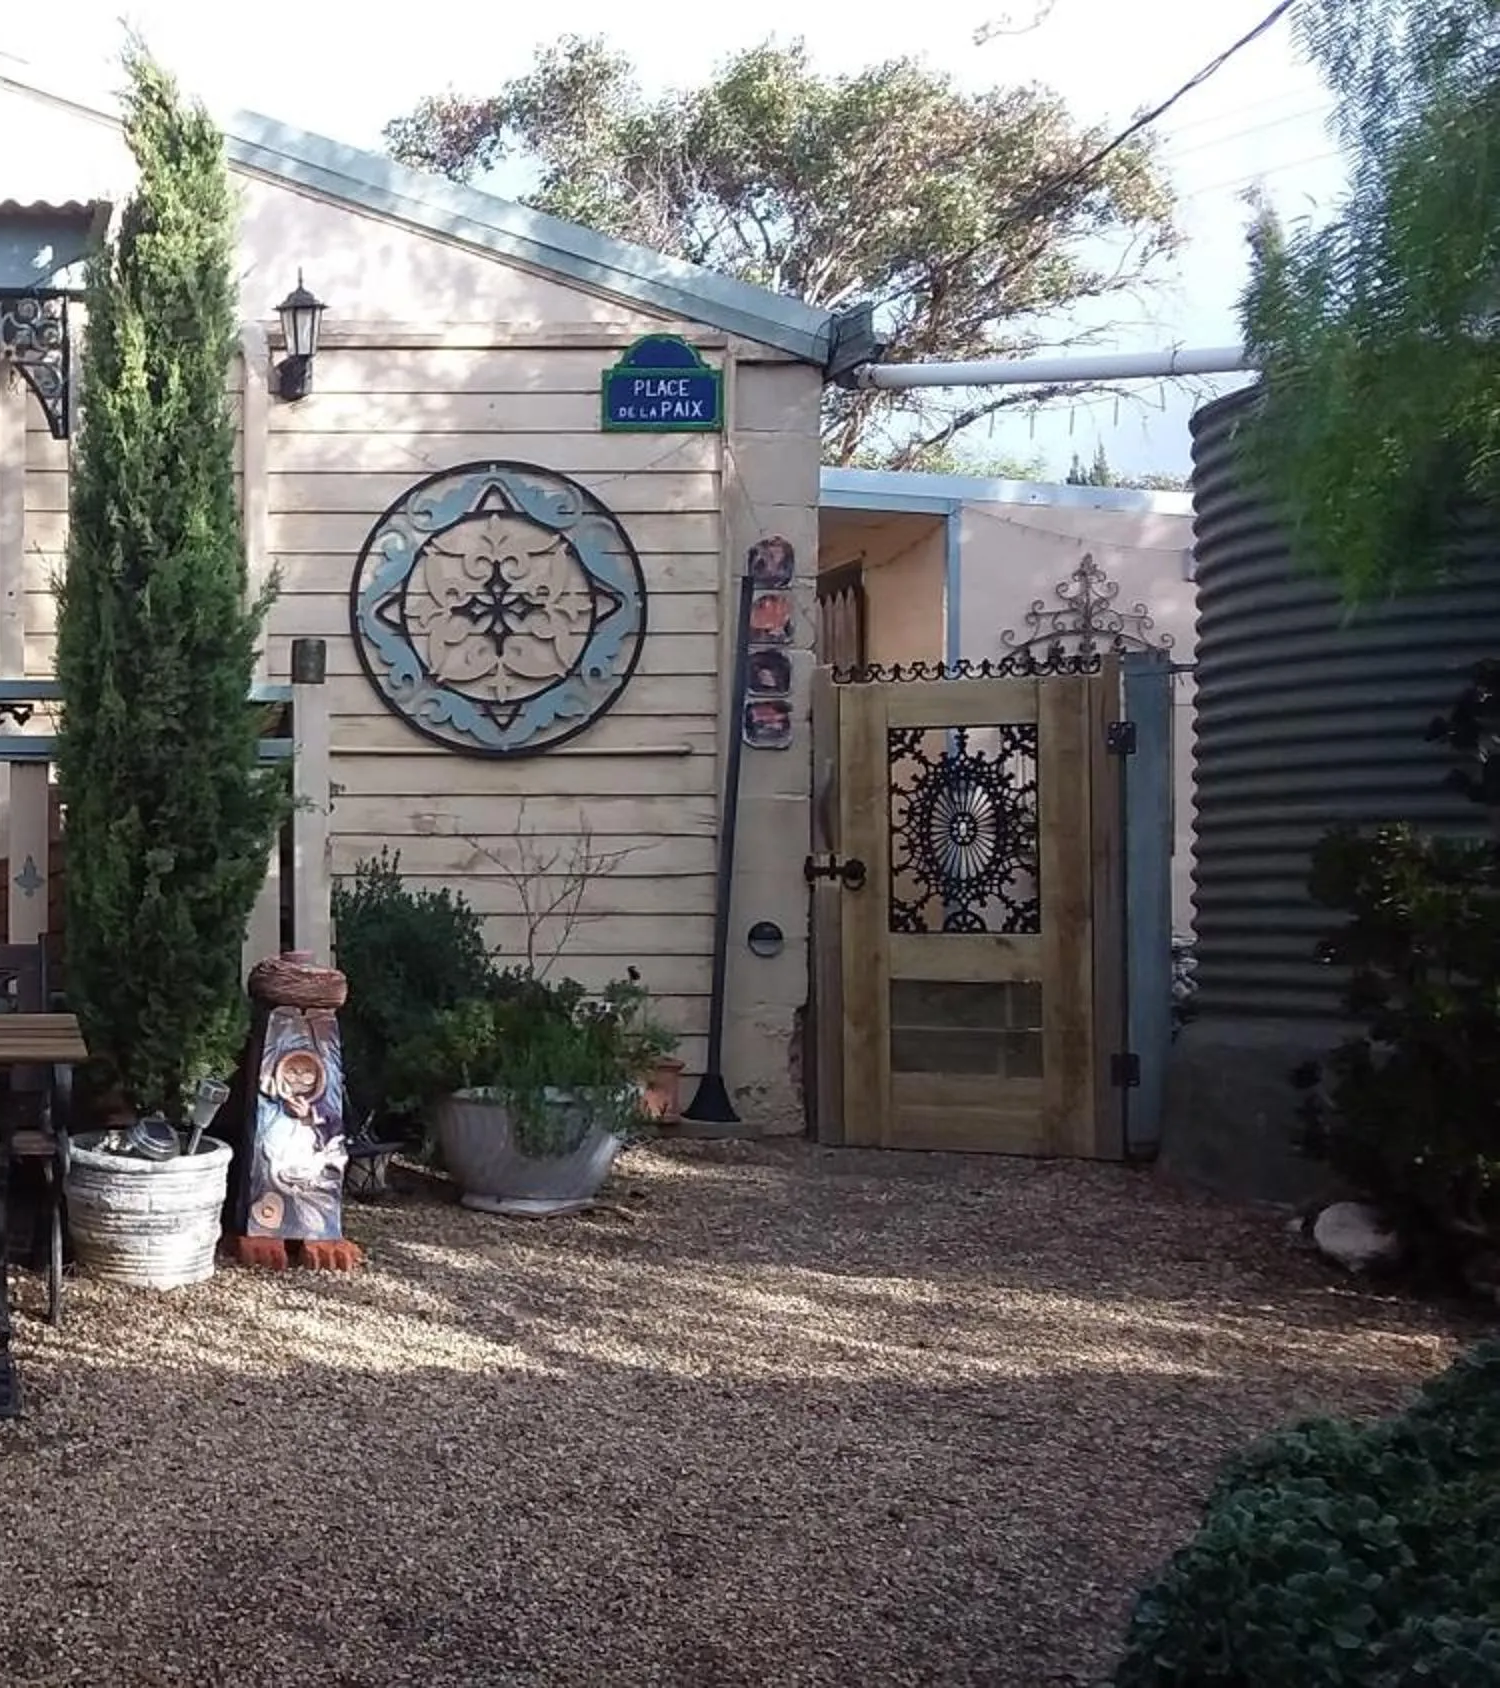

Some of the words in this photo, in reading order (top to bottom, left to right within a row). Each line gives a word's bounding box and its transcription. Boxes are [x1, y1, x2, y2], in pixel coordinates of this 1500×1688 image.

[633, 379, 690, 397] PLACE
[619, 406, 635, 418] DE
[639, 406, 657, 418] LA
[661, 400, 703, 417] PAIX
